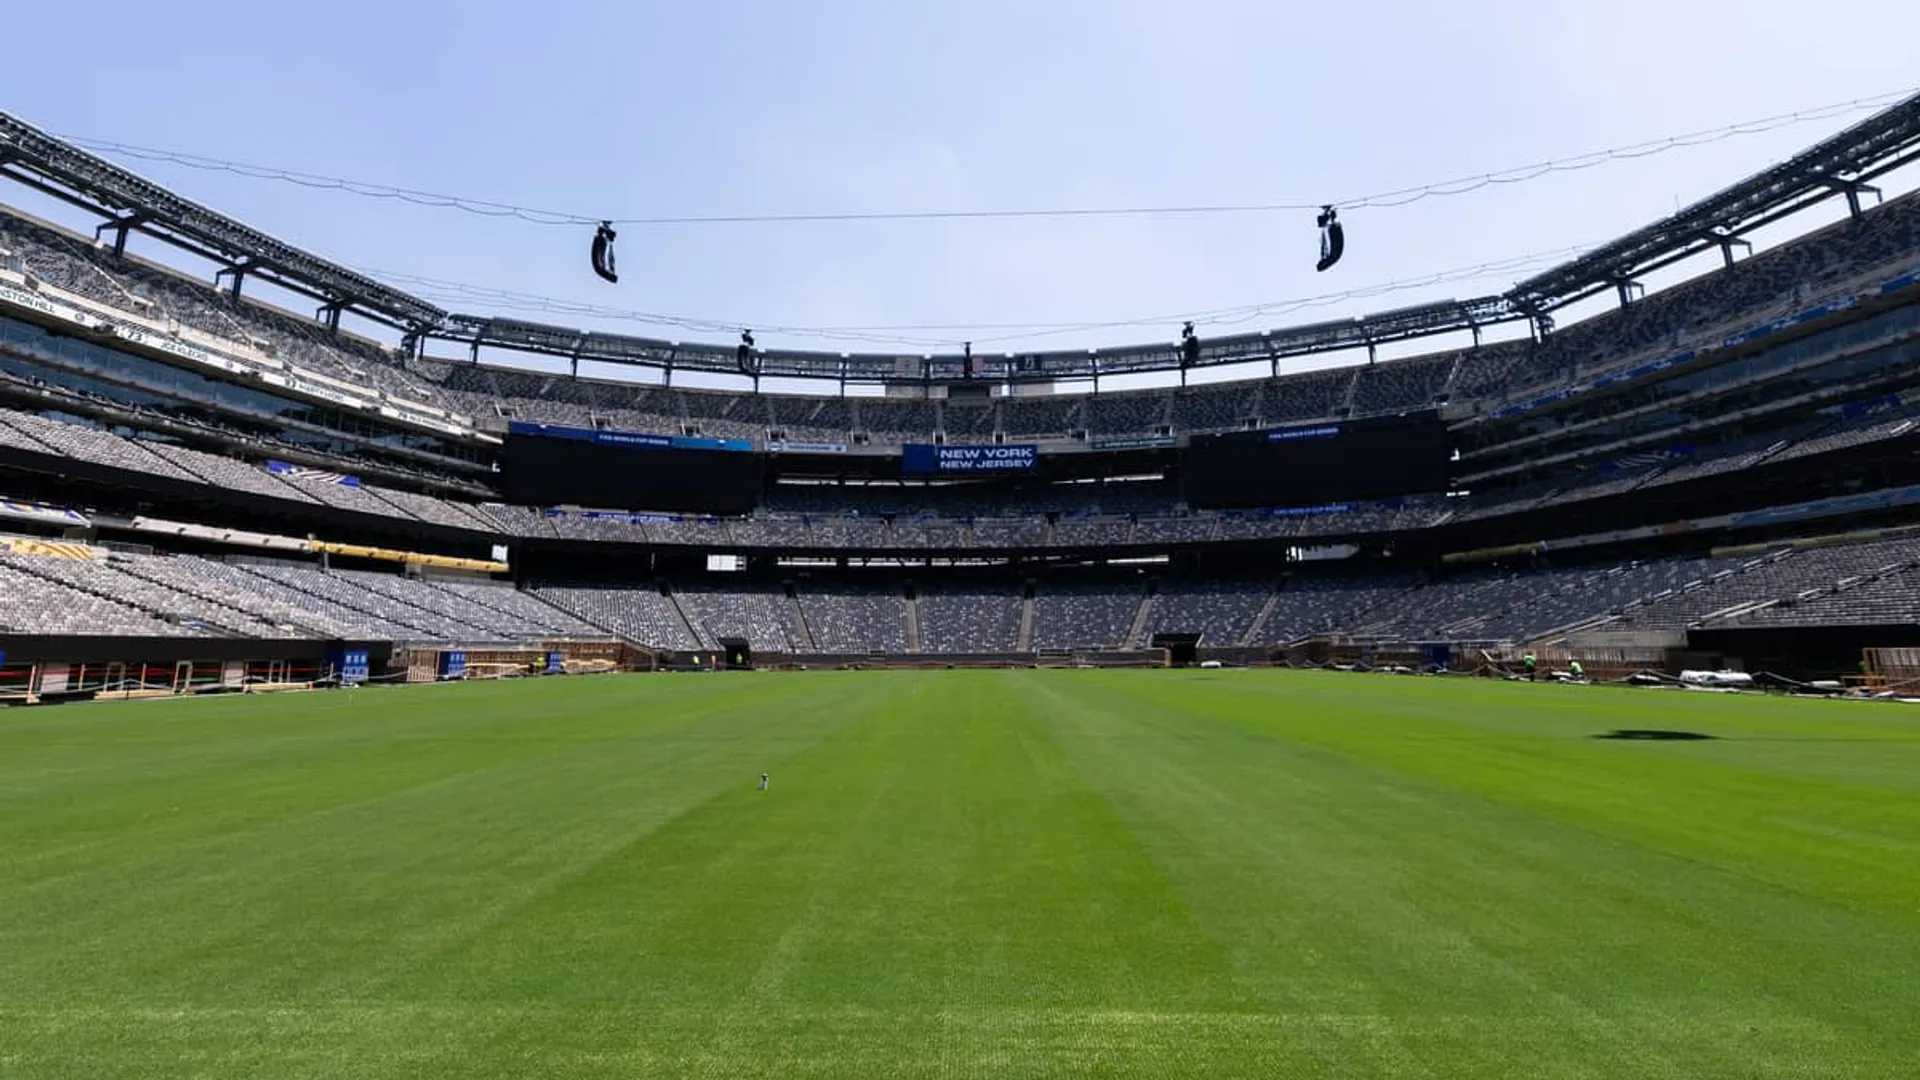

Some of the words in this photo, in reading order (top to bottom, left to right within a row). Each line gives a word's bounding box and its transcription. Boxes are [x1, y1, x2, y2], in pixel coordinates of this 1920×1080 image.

[940, 449, 980, 459] NEW
[984, 448, 1033, 459] YORK
[940, 460, 974, 469] NEW
[976, 459, 1033, 469] JERSEY
